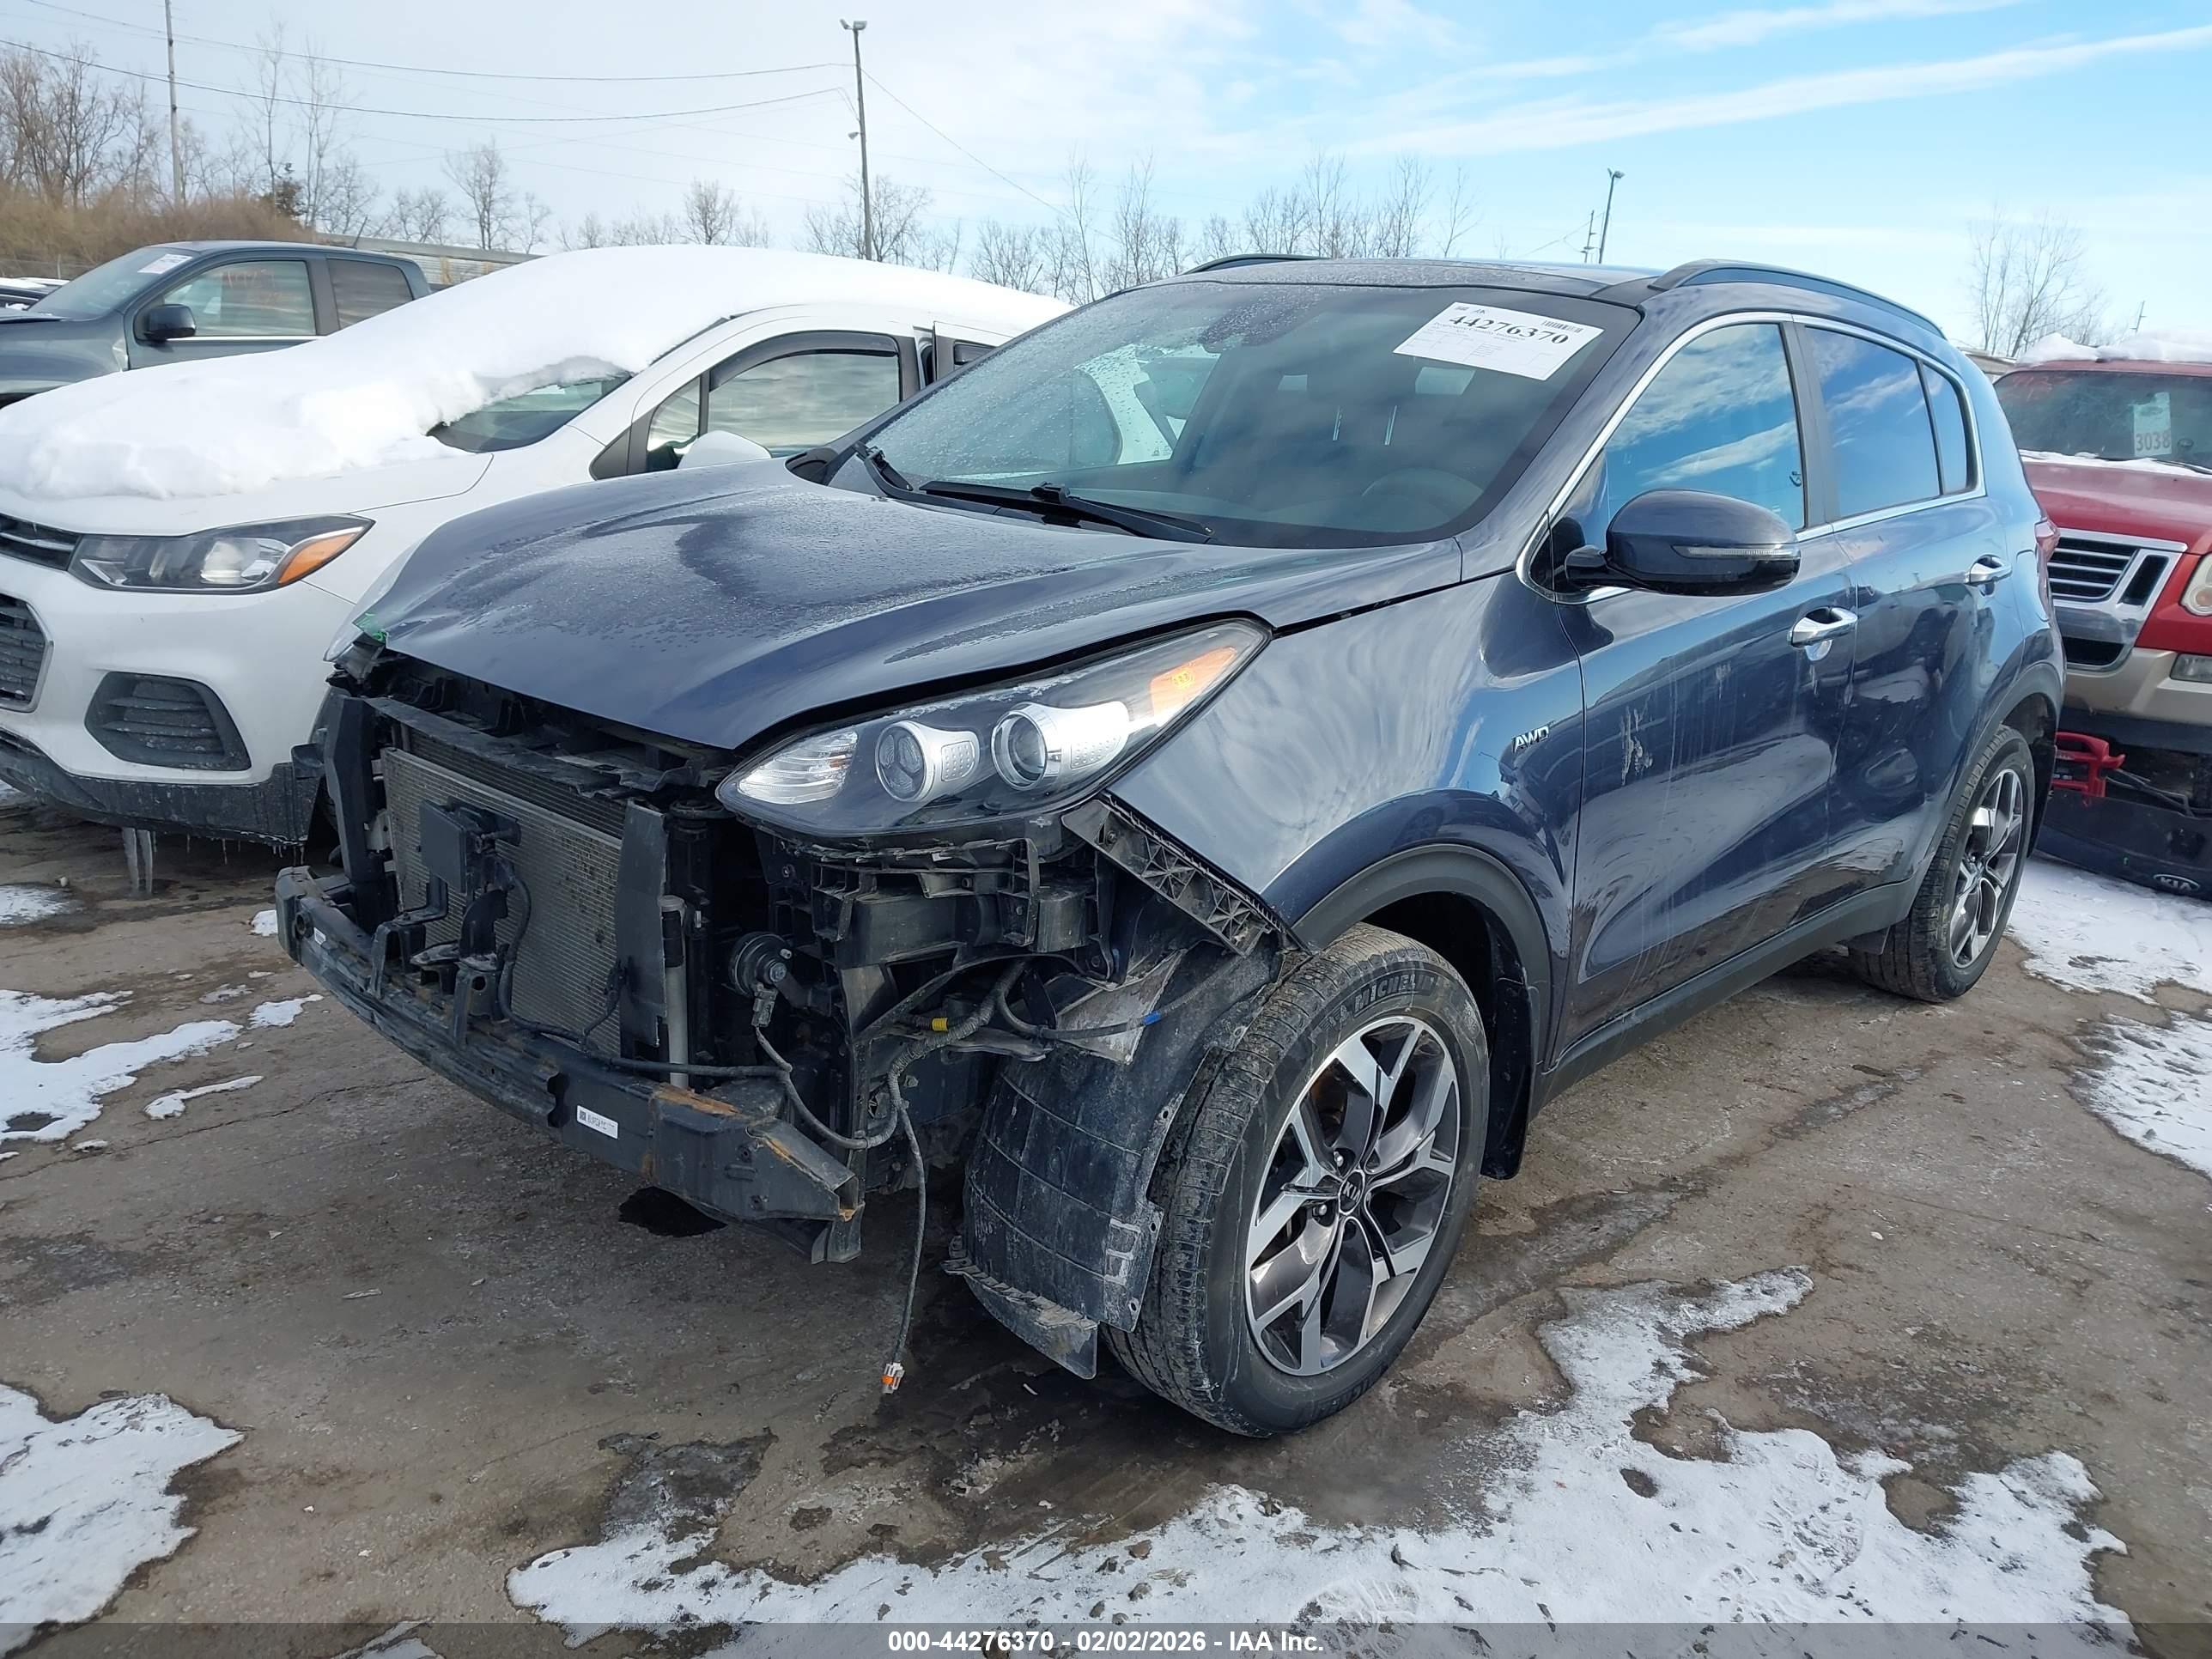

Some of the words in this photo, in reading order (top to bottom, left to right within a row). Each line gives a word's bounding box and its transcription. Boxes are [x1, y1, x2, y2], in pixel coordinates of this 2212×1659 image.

[1449, 314, 1569, 344] 44276370
[2136, 429, 2172, 452] 3038
[1513, 726, 1549, 753] AWD
[2160, 876, 2192, 892] KIA
[1342, 1181, 1361, 1203] KIA
